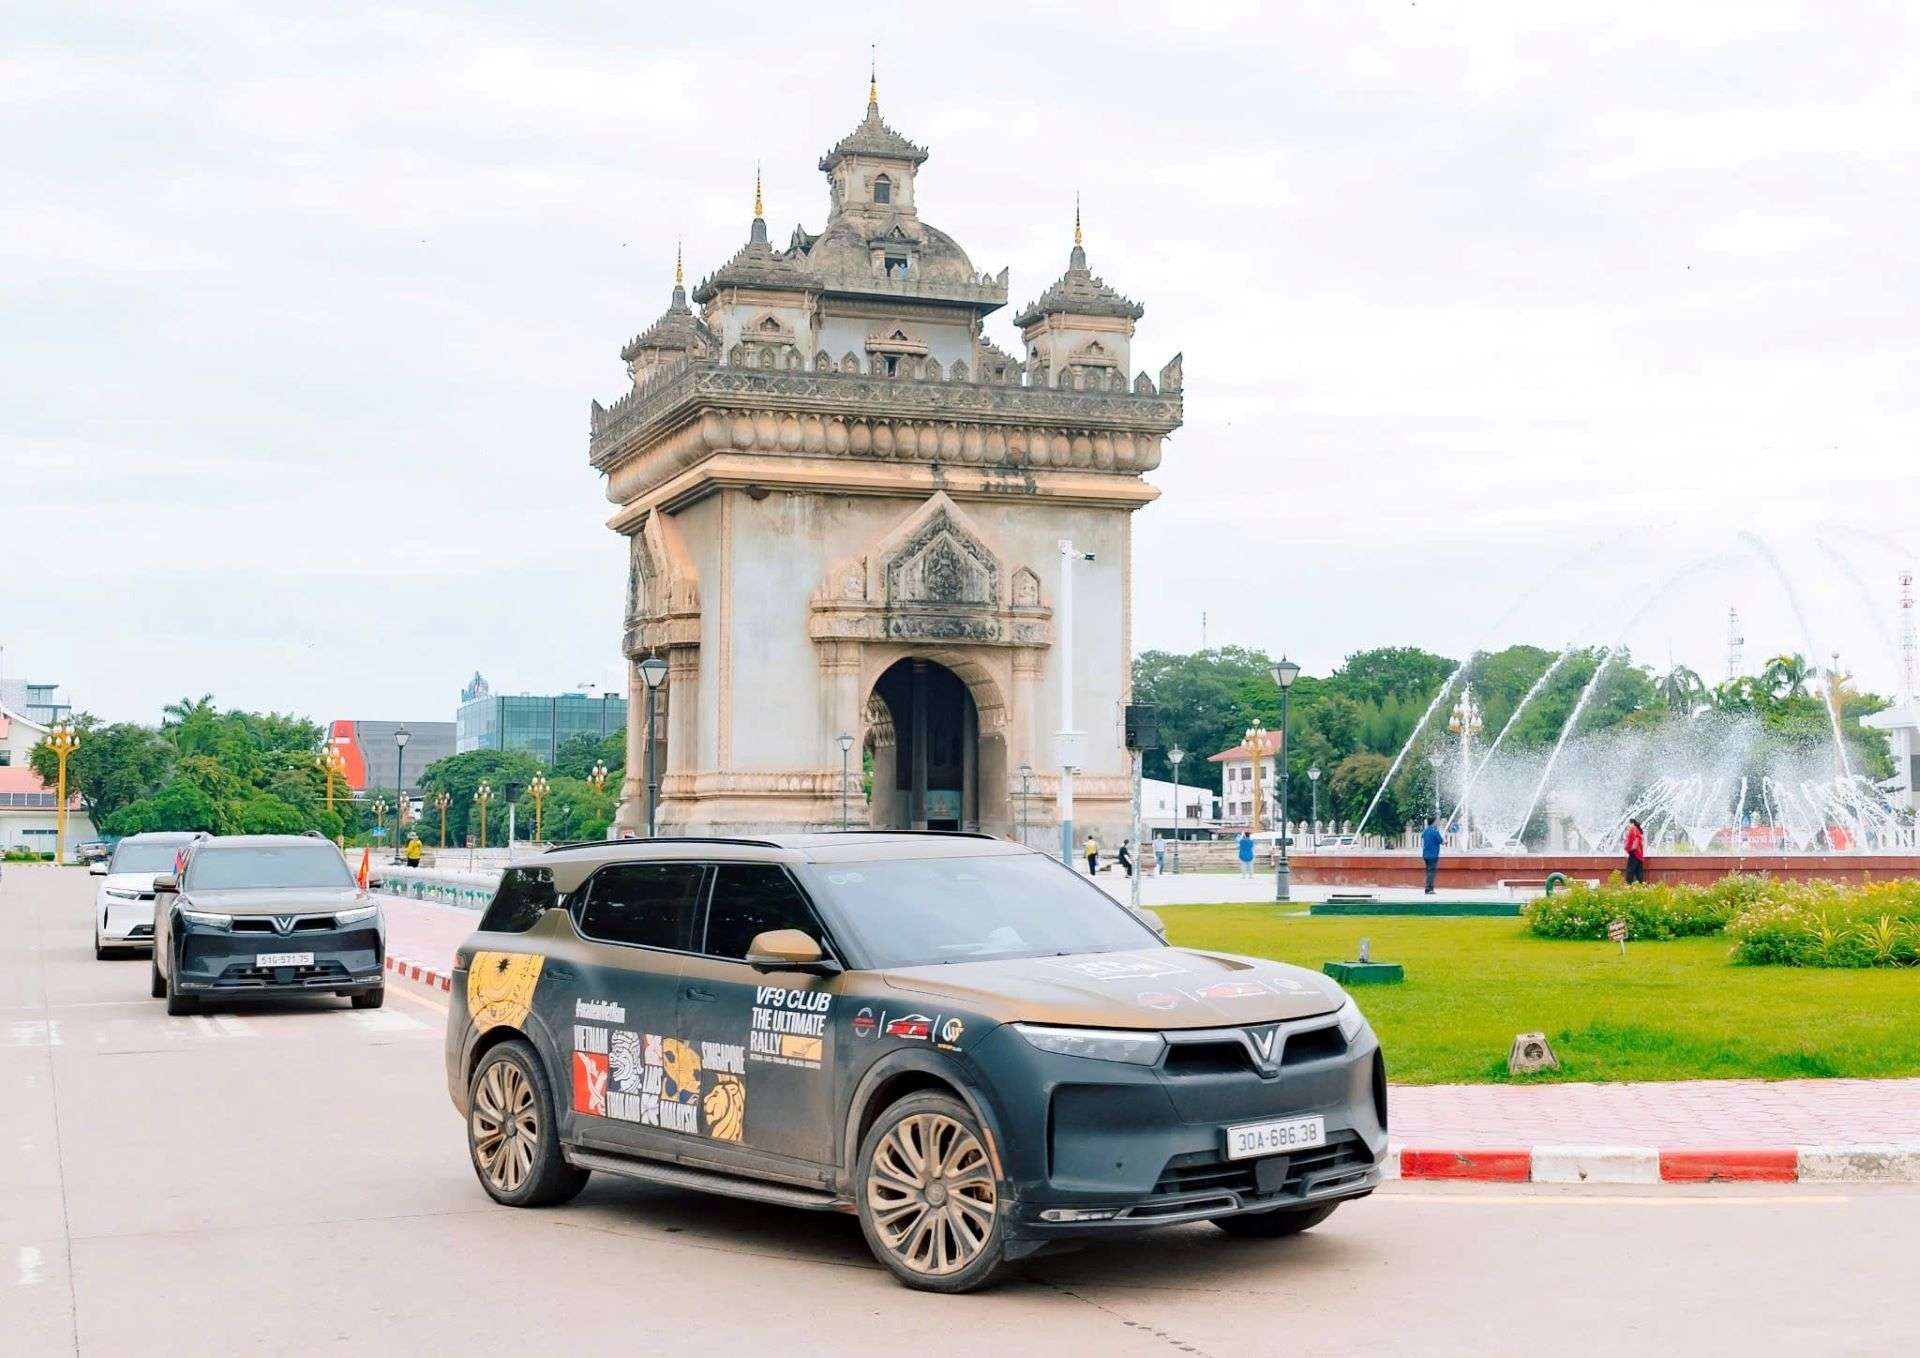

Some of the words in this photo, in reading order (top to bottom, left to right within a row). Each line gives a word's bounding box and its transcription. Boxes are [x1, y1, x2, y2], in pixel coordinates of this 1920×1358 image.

[756, 986, 786, 1007] VF9
[786, 989, 832, 1012] CLUB
[752, 1007, 773, 1030] THE
[772, 1009, 826, 1036] ULTIMATE
[750, 1030, 782, 1055] RALLY
[1237, 1123, 1318, 1152] 30A-686.38
